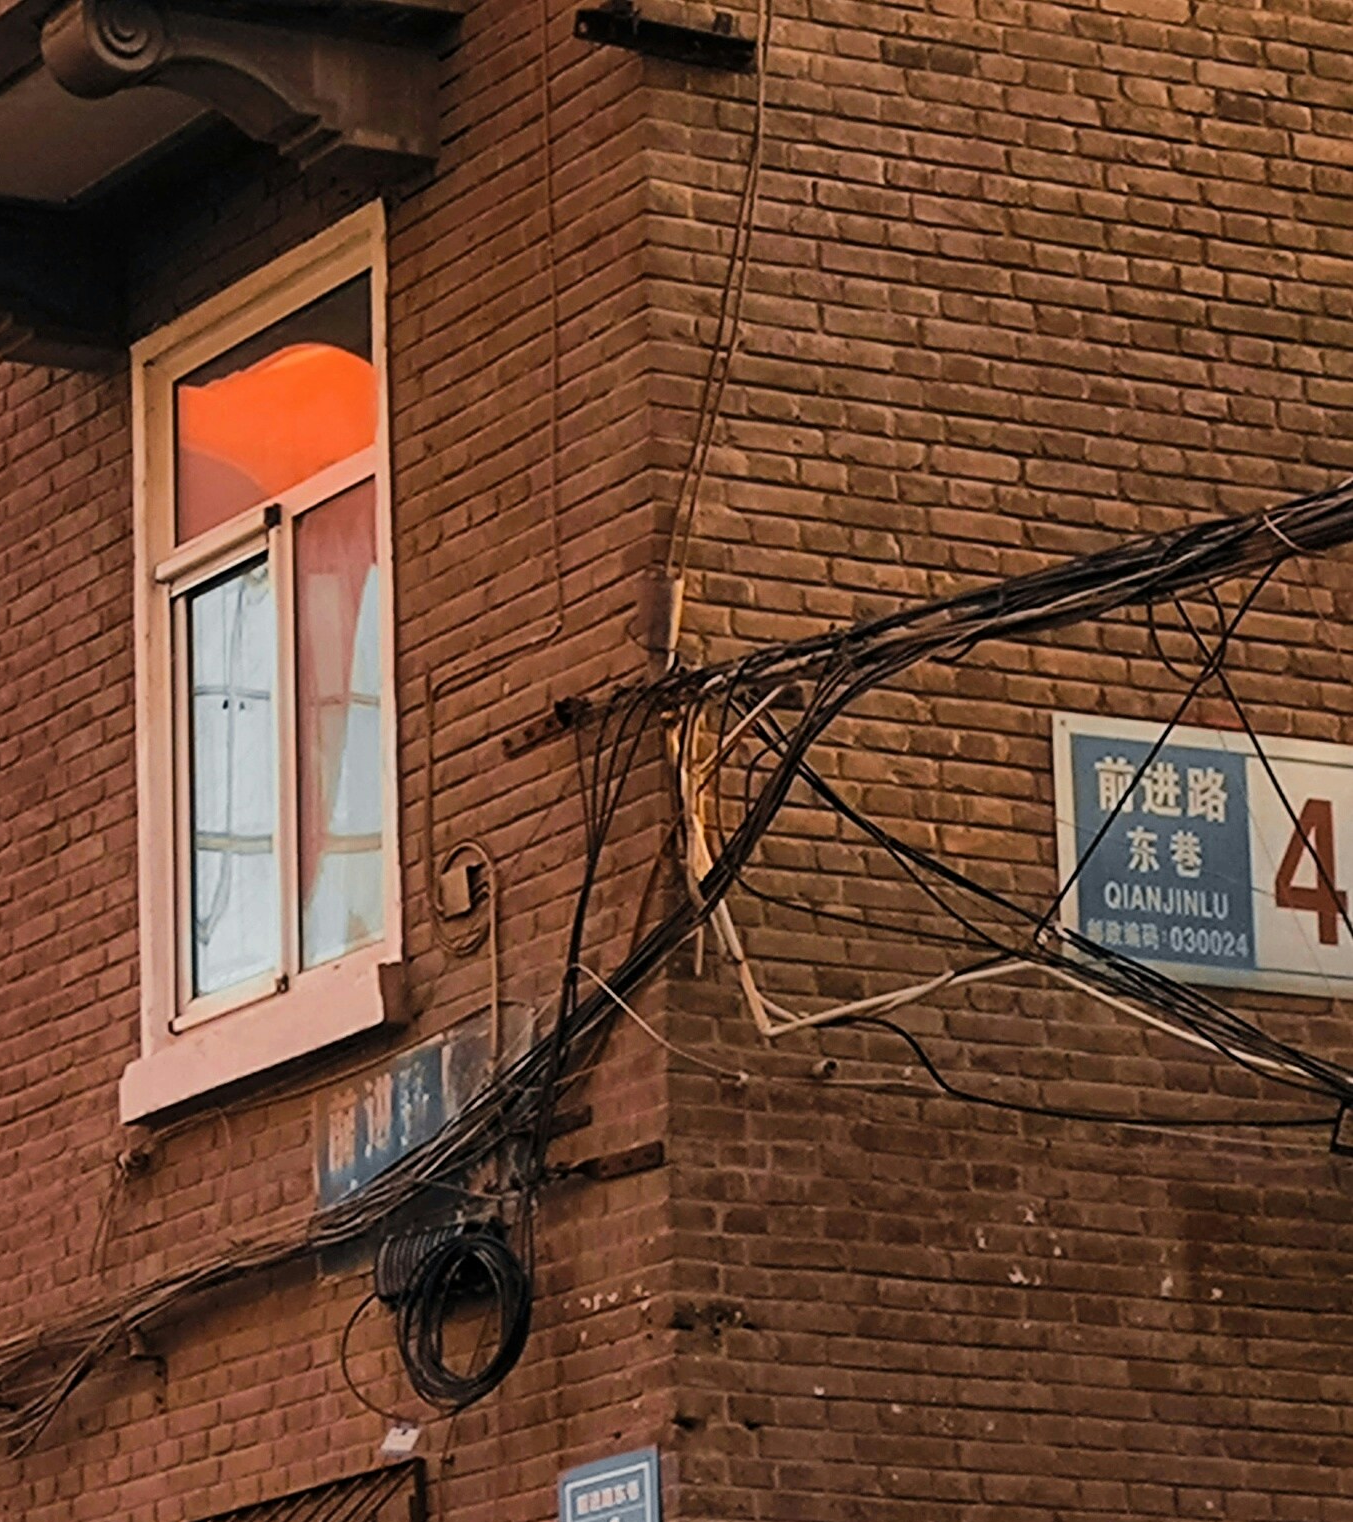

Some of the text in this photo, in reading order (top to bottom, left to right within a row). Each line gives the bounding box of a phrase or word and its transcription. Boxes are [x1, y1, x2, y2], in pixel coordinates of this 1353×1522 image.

[1094, 755, 1228, 824] 前进路
[1126, 825, 1204, 879] 东巷
[1274, 797, 1348, 946] 4
[1104, 880, 1229, 921] QIANJINLU
